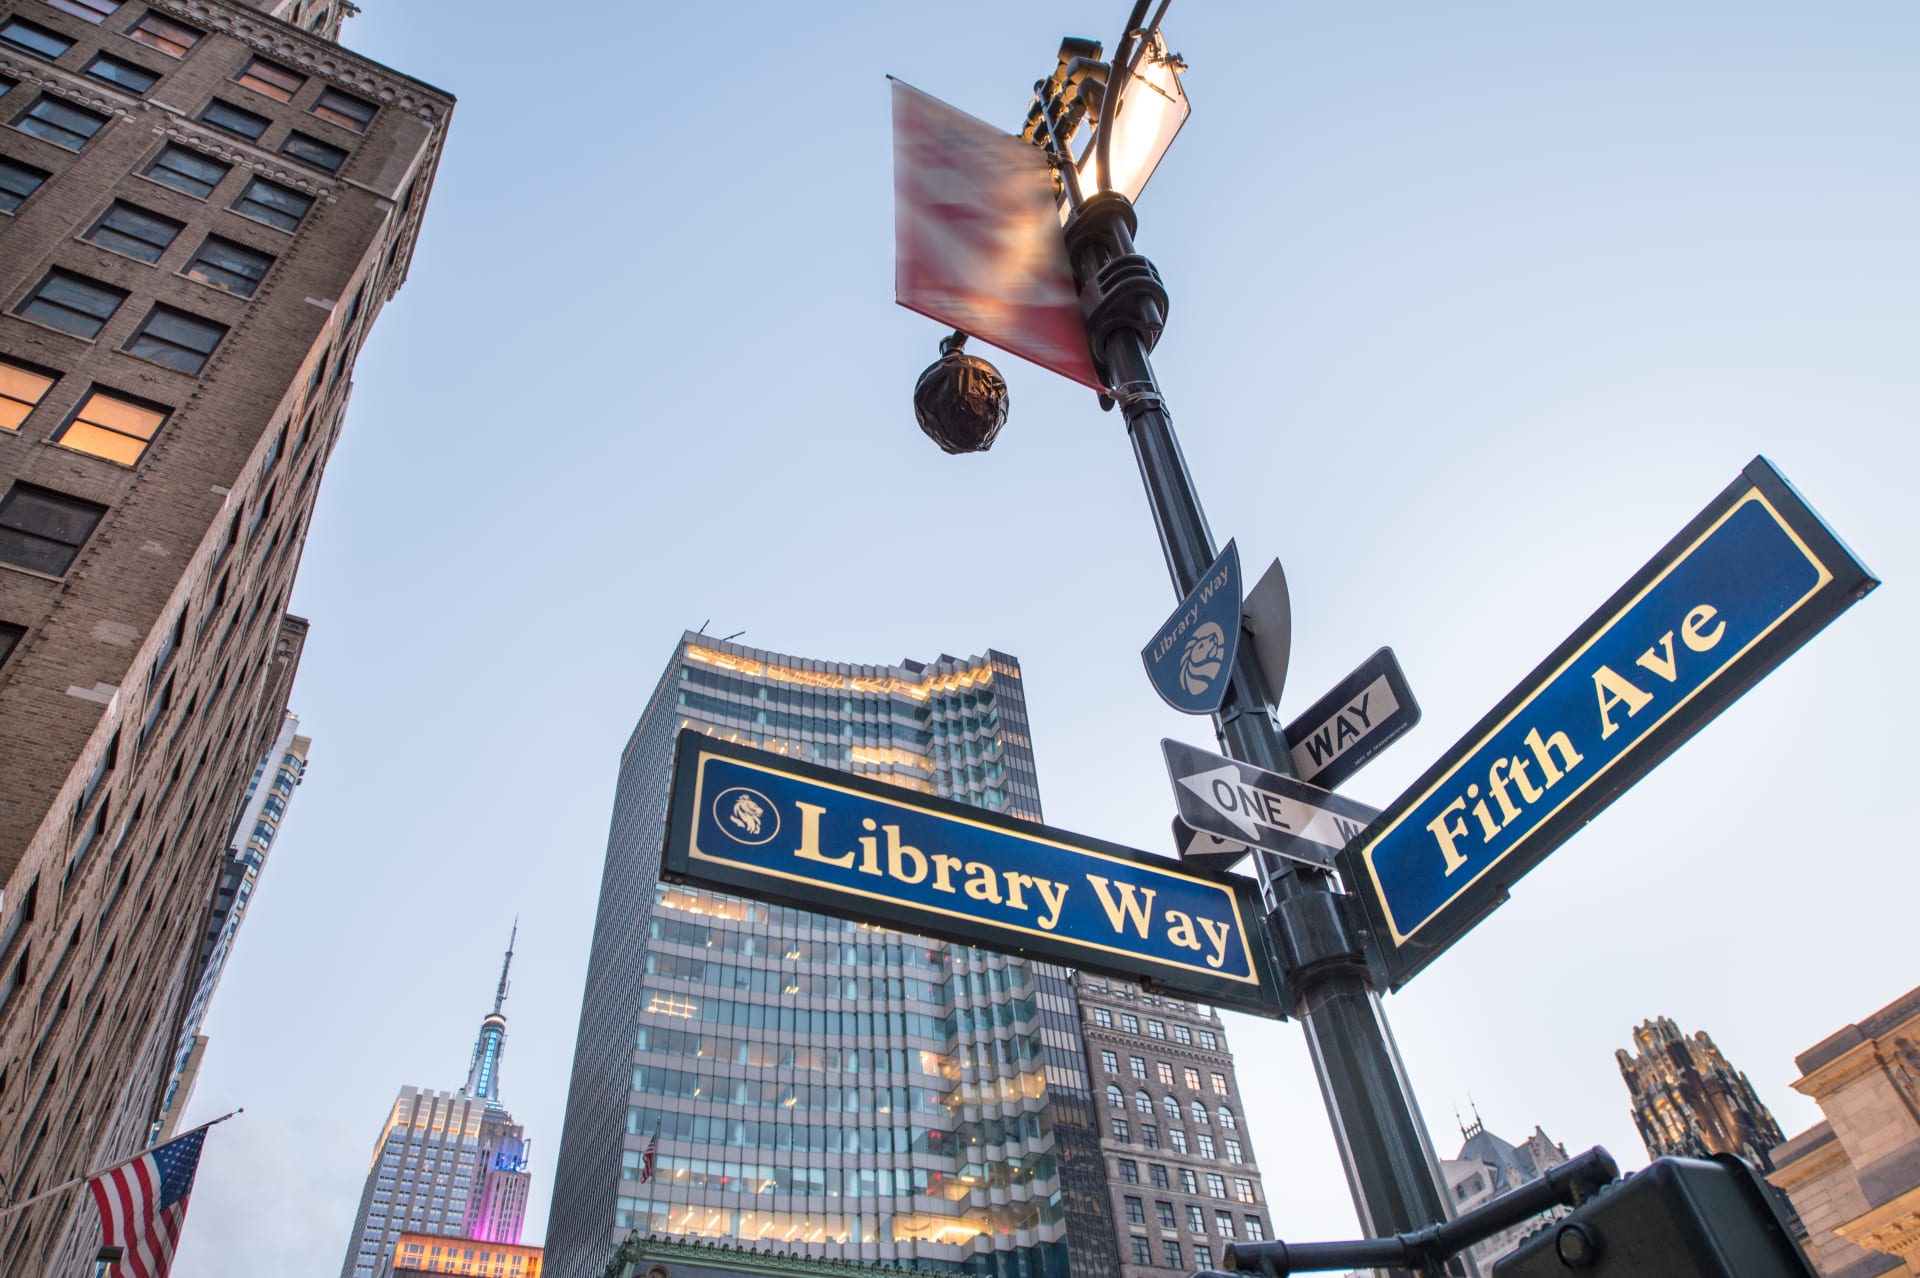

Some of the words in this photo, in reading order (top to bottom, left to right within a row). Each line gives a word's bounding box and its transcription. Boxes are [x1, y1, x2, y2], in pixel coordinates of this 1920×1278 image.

[1153, 603, 1198, 663] Library
[1200, 565, 1228, 604] Way
[1305, 692, 1371, 767] WAY
[1427, 727, 1583, 876] Fifth
[1593, 604, 1726, 739] Ave
[1212, 779, 1291, 829] ONE
[794, 801, 1069, 929] Library
[1087, 874, 1230, 972] Way
